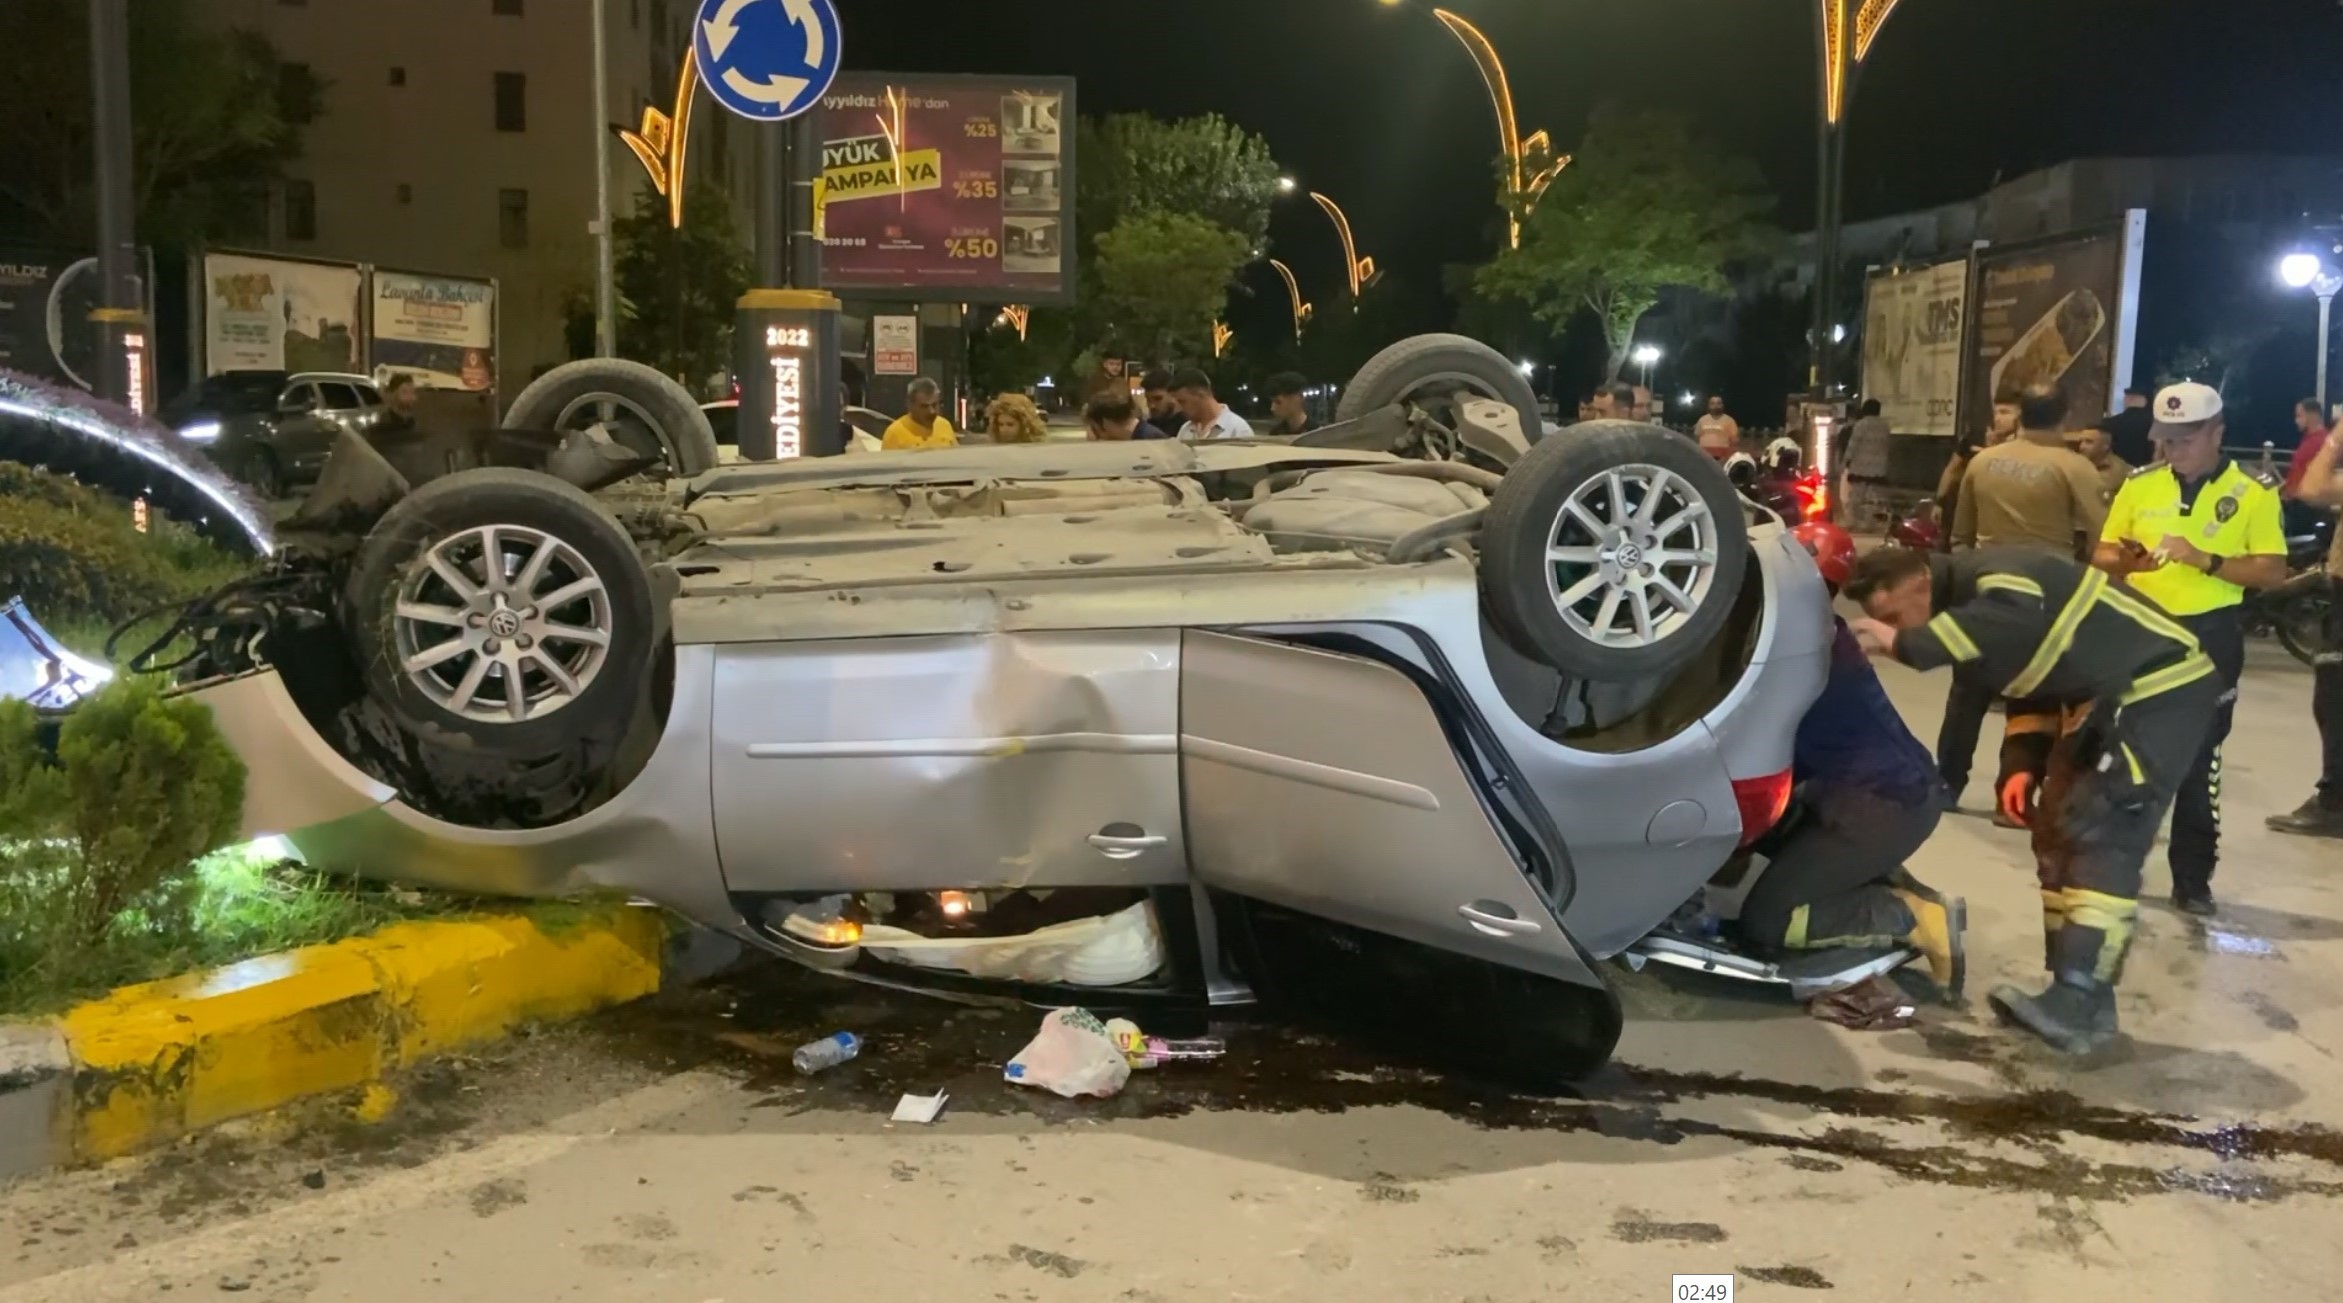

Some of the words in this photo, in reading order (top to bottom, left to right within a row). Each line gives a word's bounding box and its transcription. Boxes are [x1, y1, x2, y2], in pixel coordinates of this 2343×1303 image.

[964, 124, 997, 138] %25
[953, 180, 997, 198] %35
[944, 238, 998, 258] %50
[766, 327, 809, 347] 2022
